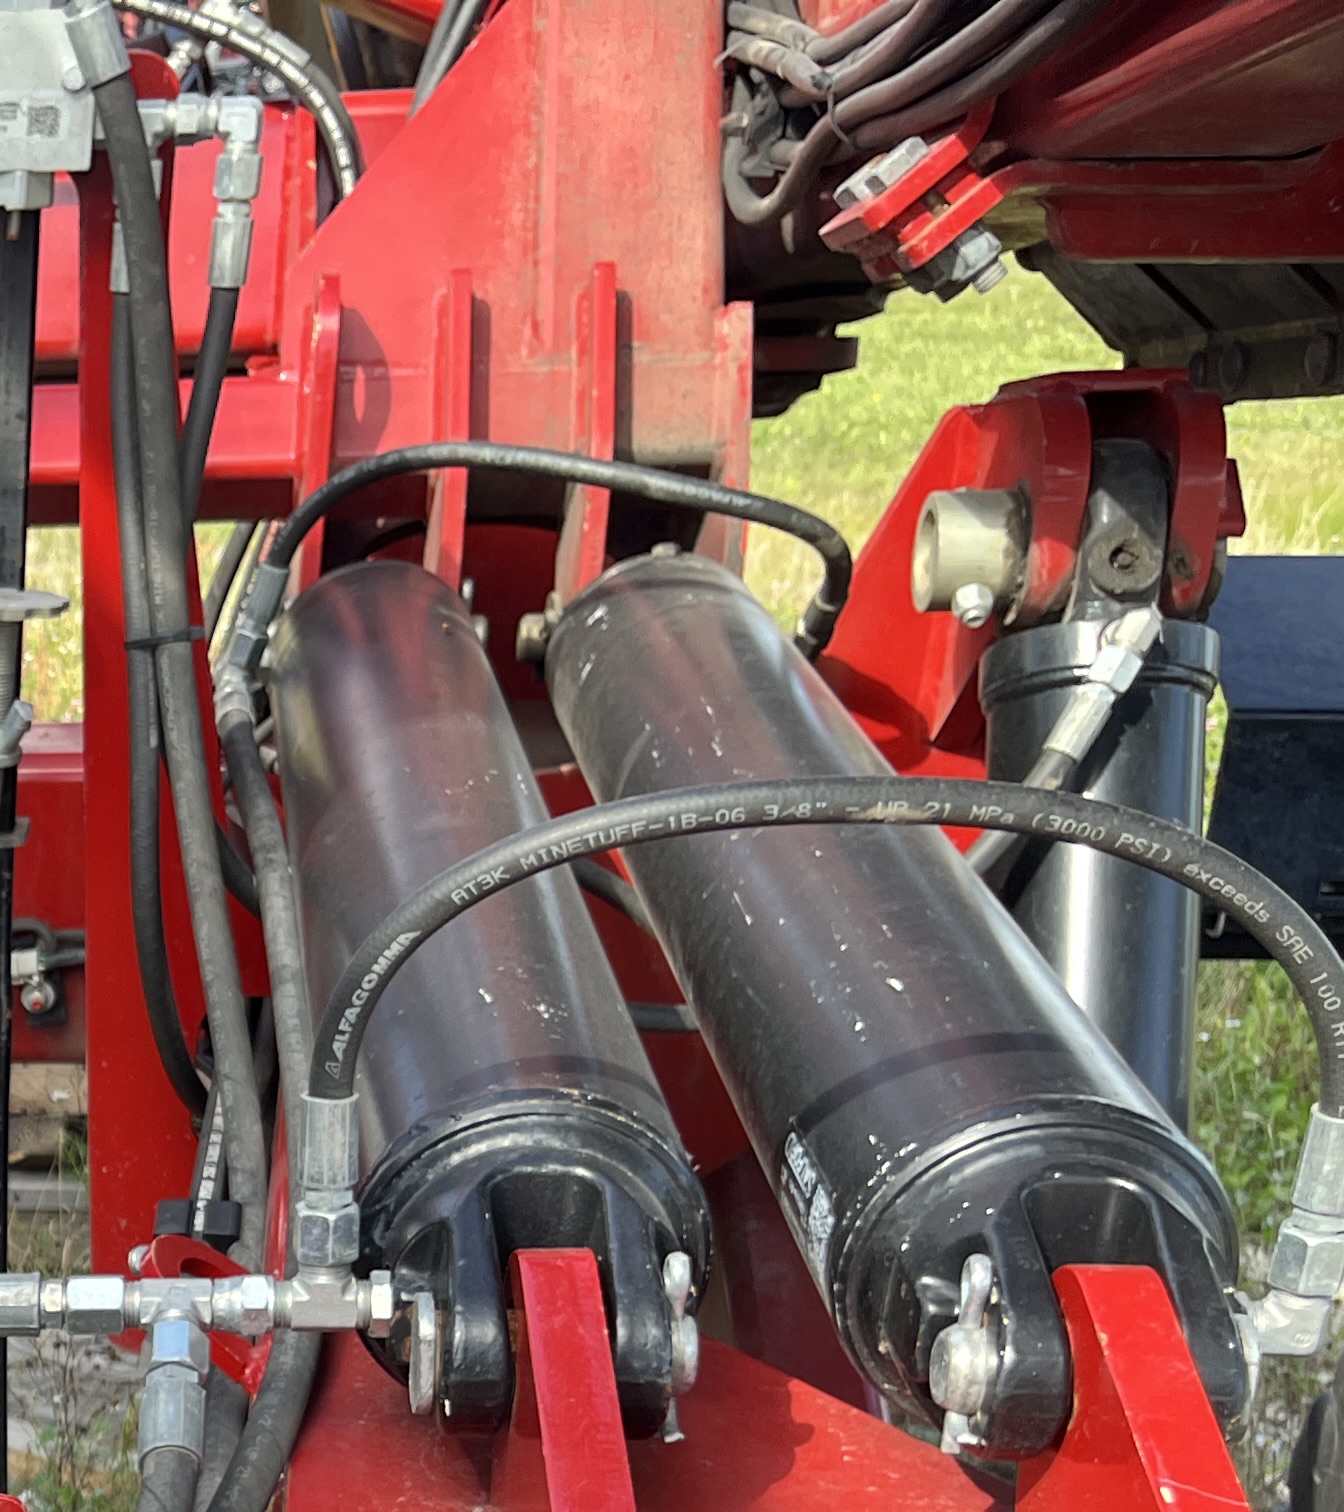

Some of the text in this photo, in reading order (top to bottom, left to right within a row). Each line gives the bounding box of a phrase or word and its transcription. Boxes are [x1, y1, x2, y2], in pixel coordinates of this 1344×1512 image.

[330, 929, 423, 1062] ALFAGOMMA
[450, 866, 511, 906] AT3K
[519, 807, 746, 871] MINETUFF-1B-06
[923, 801, 952, 819] 21
[968, 804, 1015, 824] MPa
[1031, 812, 1106, 842] (3000
[1115, 832, 1172, 863] PSI)
[1183, 863, 1272, 924] exceeds
[1275, 925, 1316, 966] SAE
[1309, 971, 1342, 1012] 100
